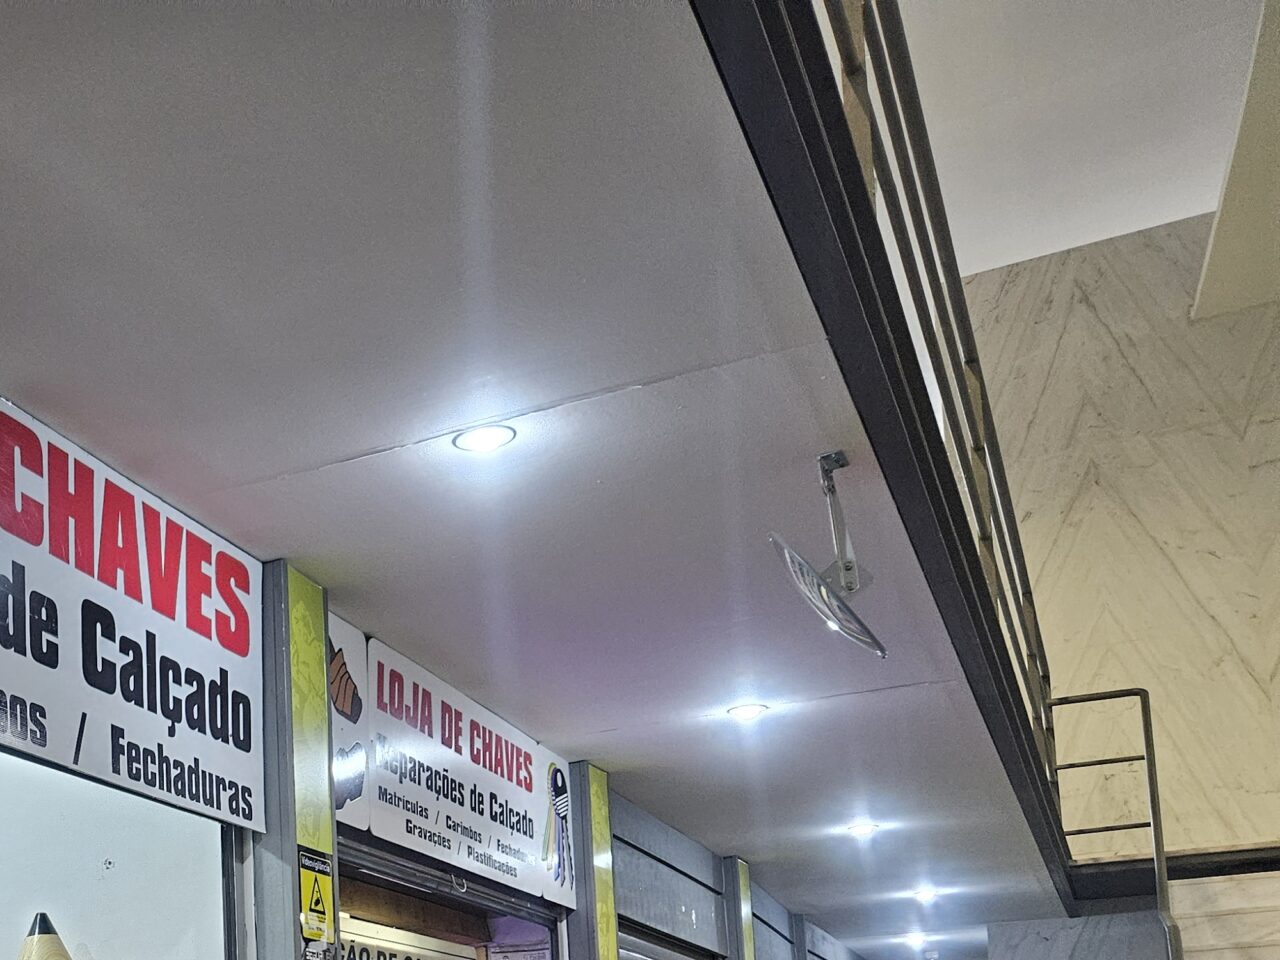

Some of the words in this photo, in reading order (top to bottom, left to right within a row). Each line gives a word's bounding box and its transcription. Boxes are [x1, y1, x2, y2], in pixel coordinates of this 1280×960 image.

[81, 599, 251, 753] Calçado
[72, 712, 87, 765] /
[110, 724, 253, 822] Fechaduras
[377, 660, 433, 739] LOJA
[441, 700, 463, 756] DE
[470, 718, 533, 793] CHAVES
[405, 818, 452, 850] Gravações
[467, 845, 518, 877] Plastificações
[445, 814, 482, 844] Carimbos
[470, 783, 484, 816] de
[489, 791, 534, 840] Calçado
